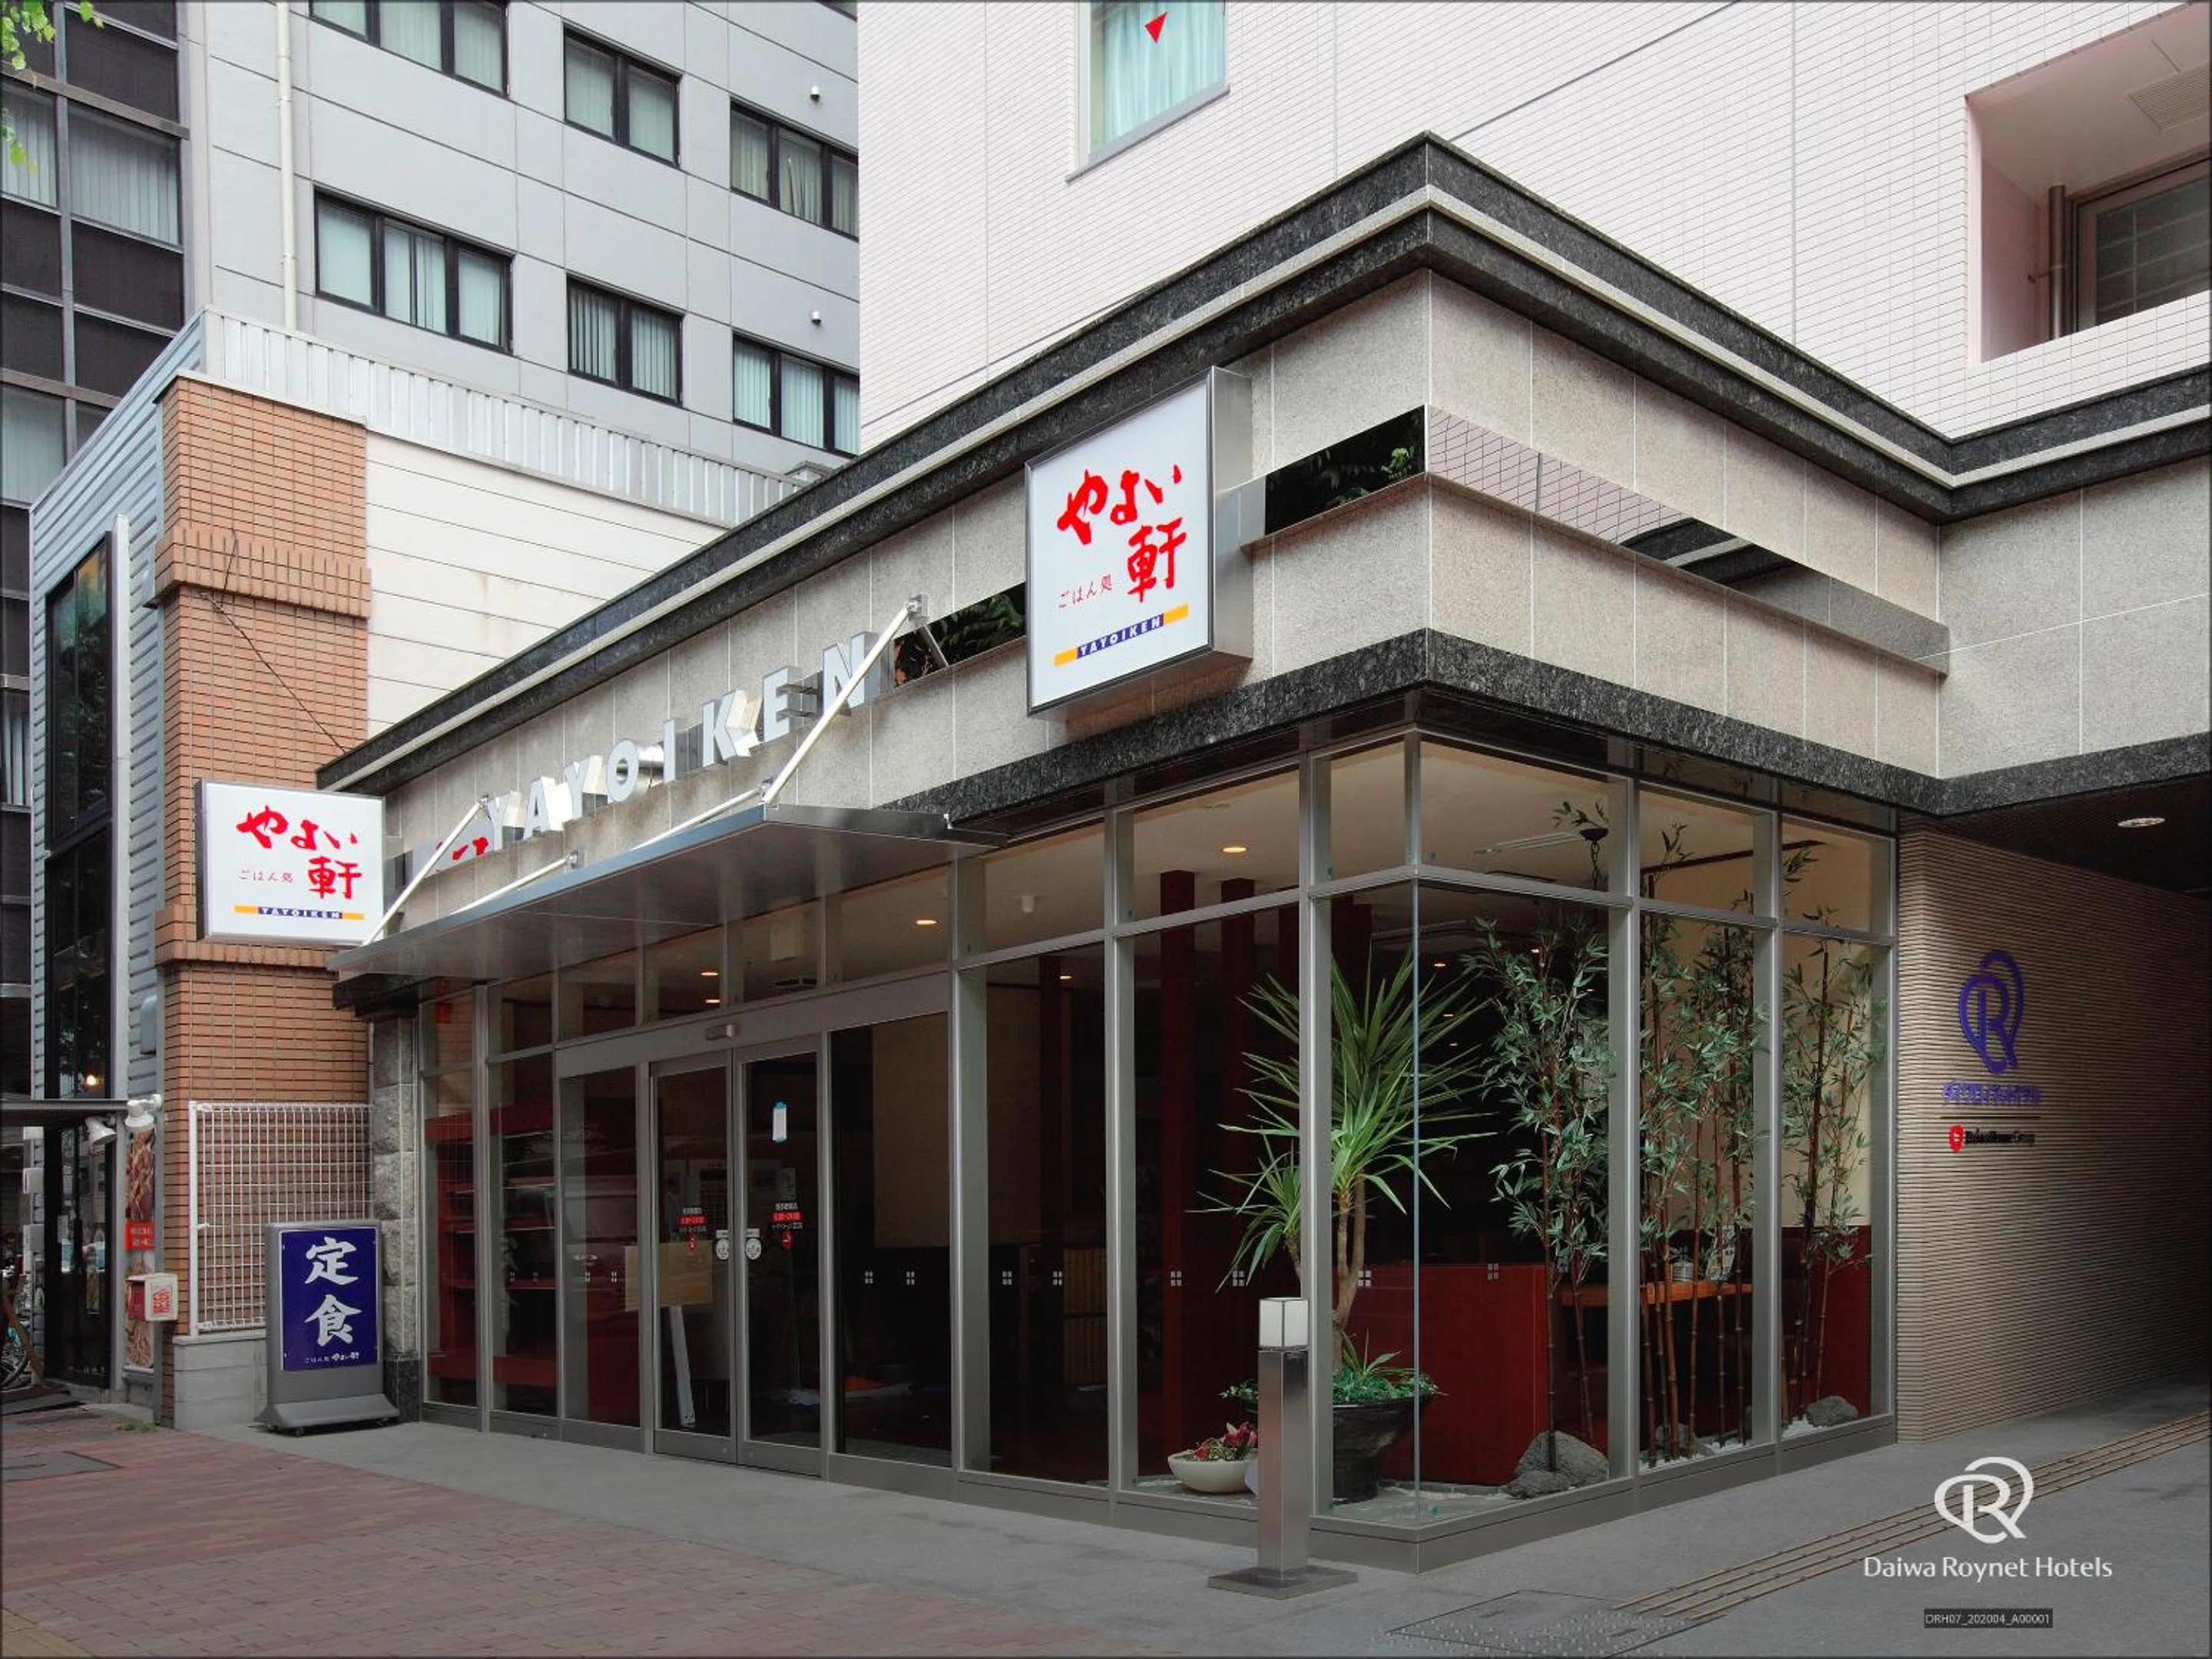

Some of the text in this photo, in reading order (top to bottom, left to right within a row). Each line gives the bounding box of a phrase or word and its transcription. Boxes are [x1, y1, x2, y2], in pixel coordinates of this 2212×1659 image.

[1057, 464, 1182, 545] やよい
[1127, 517, 1187, 603] 軒
[1058, 574, 1113, 608] ごはん処
[1080, 615, 1161, 656] YAYOIKEN
[487, 630, 883, 851] YAYOIKEN
[236, 805, 359, 850] やよい
[308, 856, 363, 899] 軒
[261, 906, 340, 919] YAYOIKEN
[304, 1236, 363, 1347] 定食
